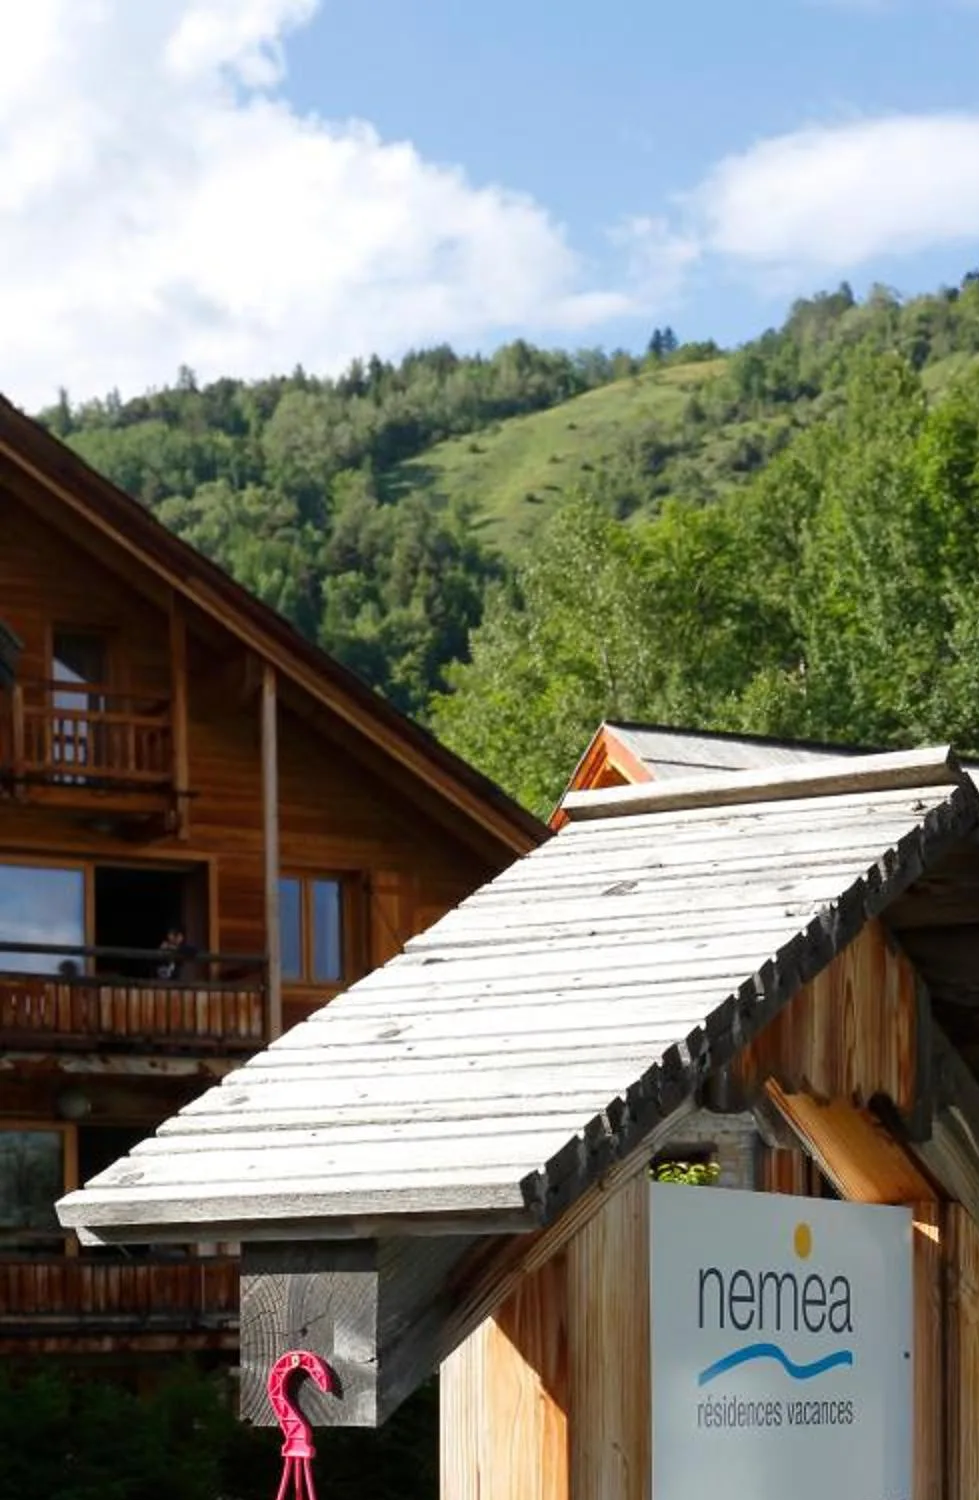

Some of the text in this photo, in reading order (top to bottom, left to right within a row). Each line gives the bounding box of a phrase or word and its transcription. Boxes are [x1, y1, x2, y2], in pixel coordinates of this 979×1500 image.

[698, 1266, 853, 1333] nemea
[697, 1395, 854, 1428] résidences vacances
